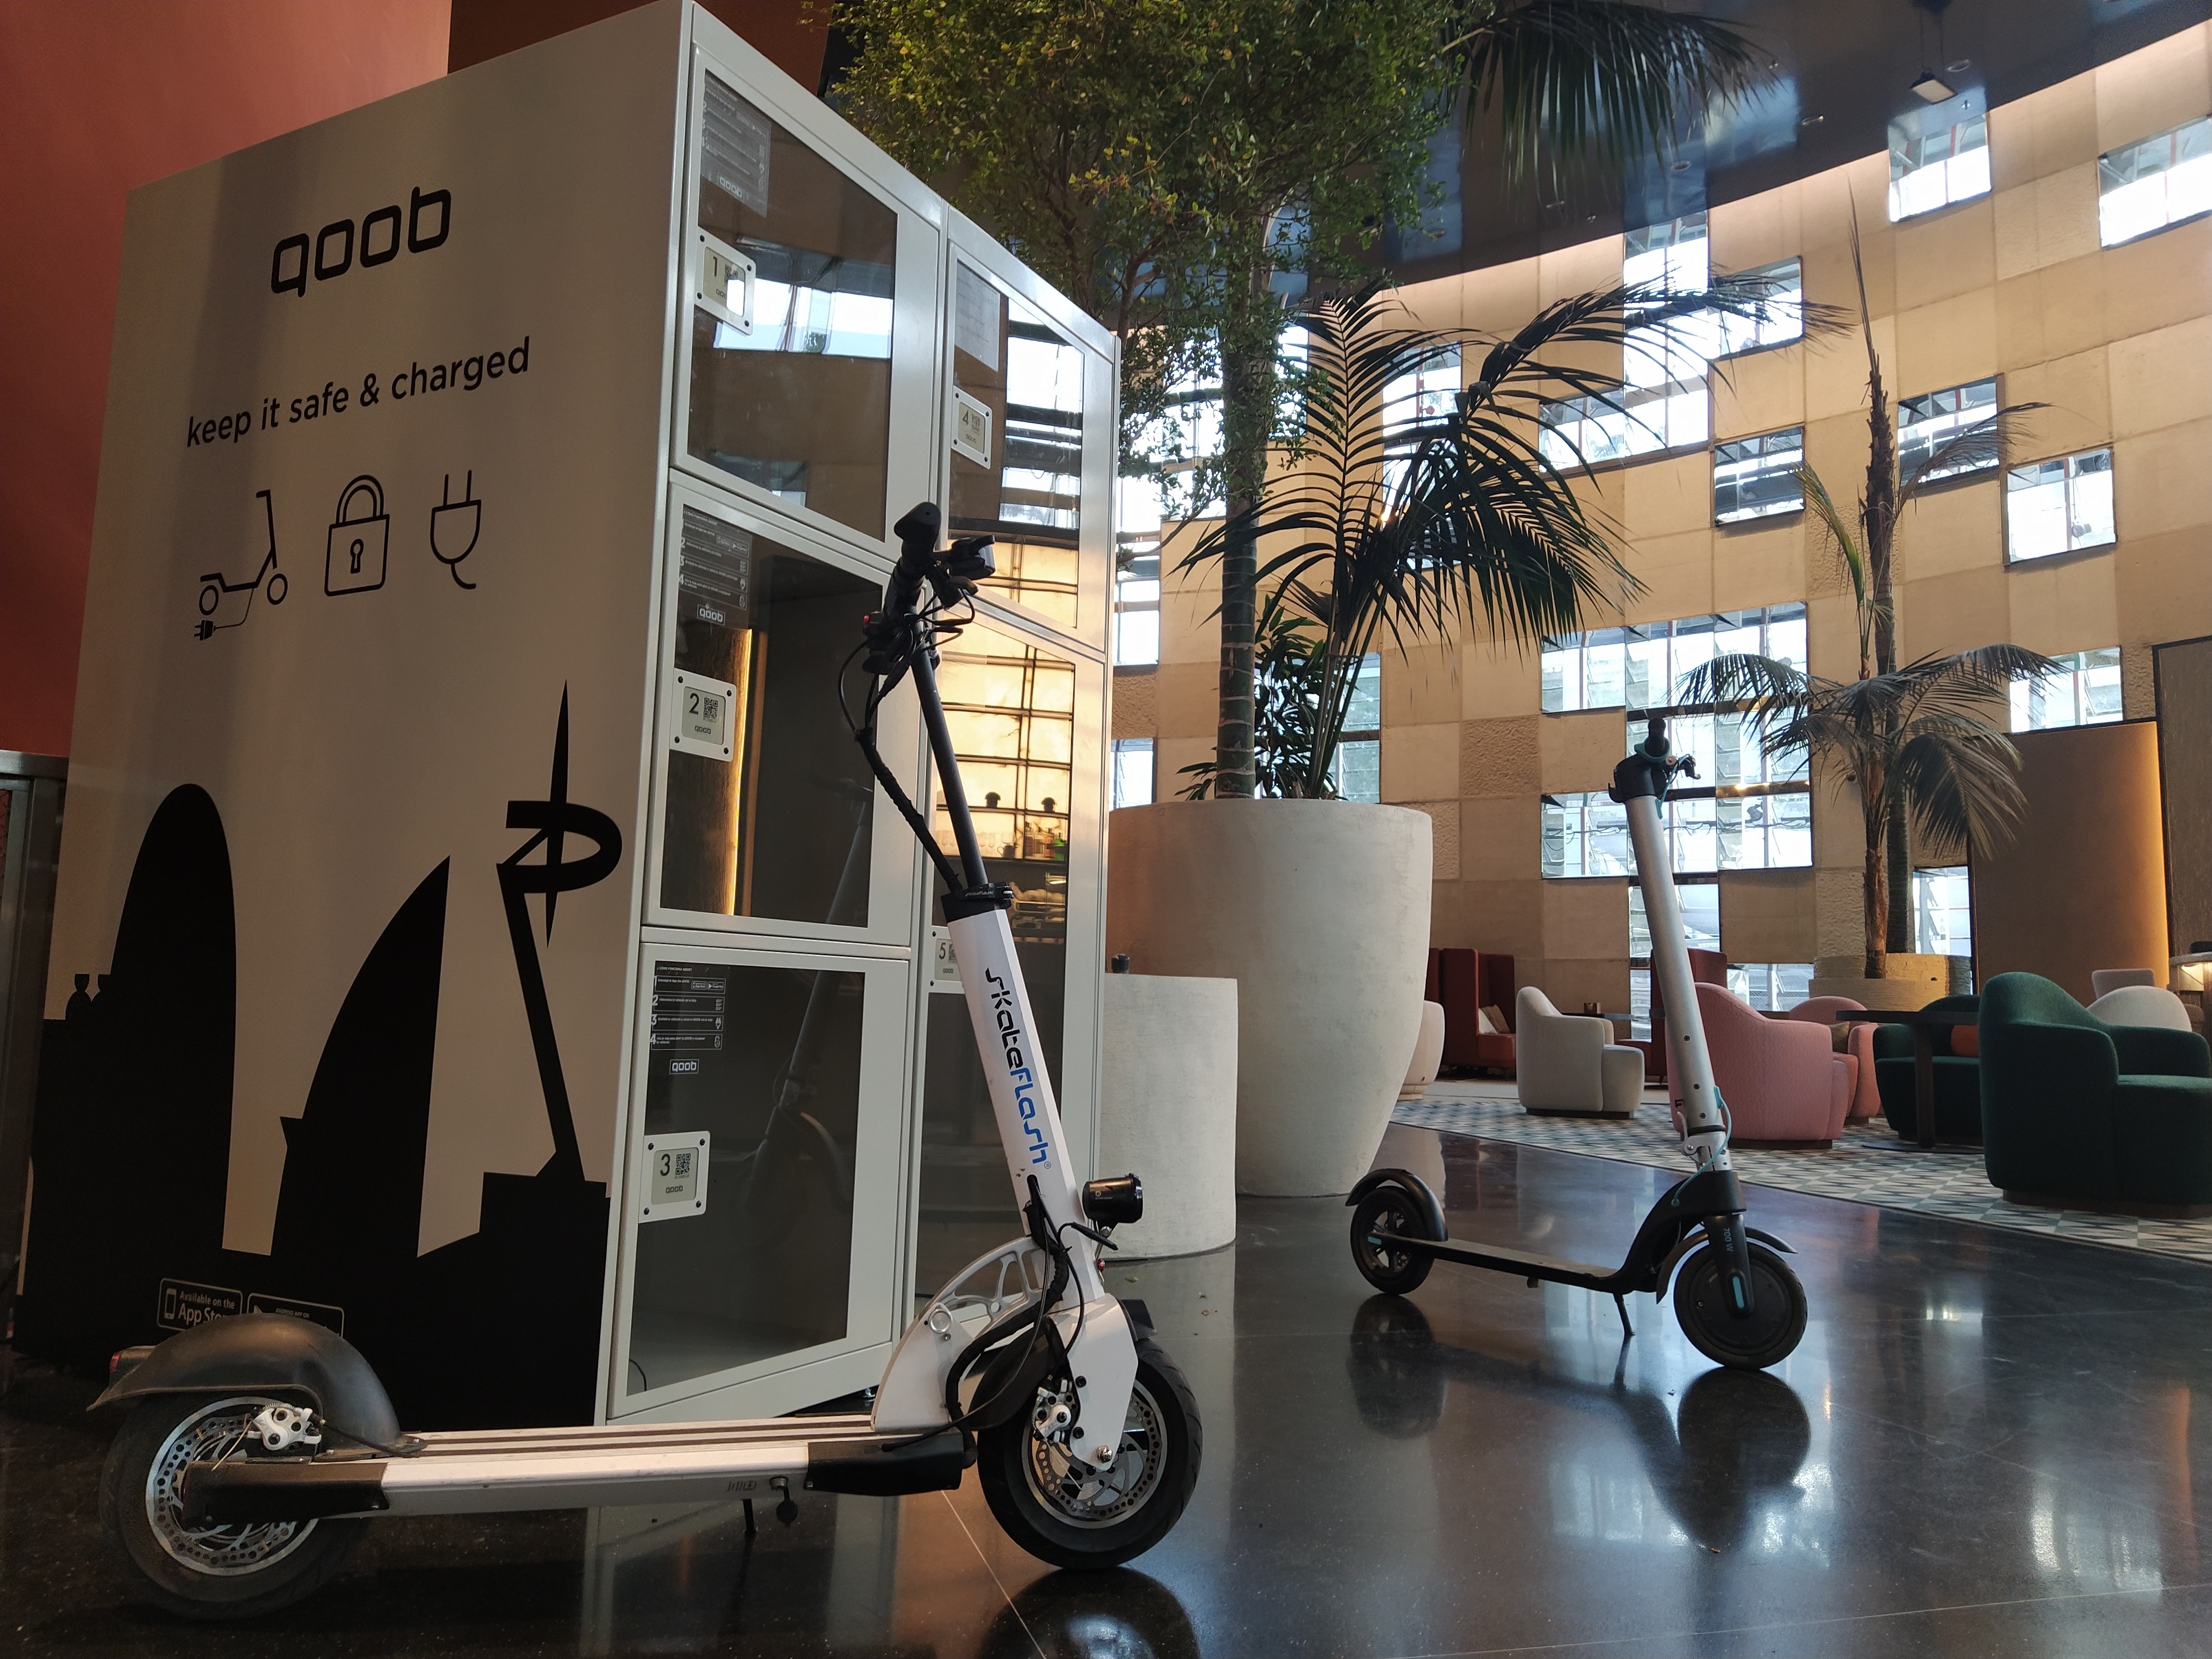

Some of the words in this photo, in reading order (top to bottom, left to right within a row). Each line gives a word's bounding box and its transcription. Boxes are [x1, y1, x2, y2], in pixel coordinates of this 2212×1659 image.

[719, 176, 742, 198] qoob
[271, 186, 451, 298] qoob
[713, 256, 718, 277] 1
[186, 410, 251, 447] keep
[261, 398, 280, 430] it
[289, 381, 349, 423] safe
[359, 373, 380, 406] &
[392, 336, 530, 400] charged
[962, 410, 969, 425] 4
[679, 573, 684, 585] 4
[700, 608, 723, 623] qoob
[689, 692, 699, 714] 2
[695, 725, 711, 734] qoob
[939, 942, 946, 959] 5
[652, 994, 659, 1006] 2
[651, 1014, 658, 1025] 3
[649, 1034, 656, 1045] 4
[672, 1061, 697, 1073] qoob
[660, 1154, 670, 1176] 3
[180, 1290, 211, 1305] Available
[212, 1298, 222, 1307] on
[223, 1298, 235, 1310] the
[178, 1303, 202, 1327] App
